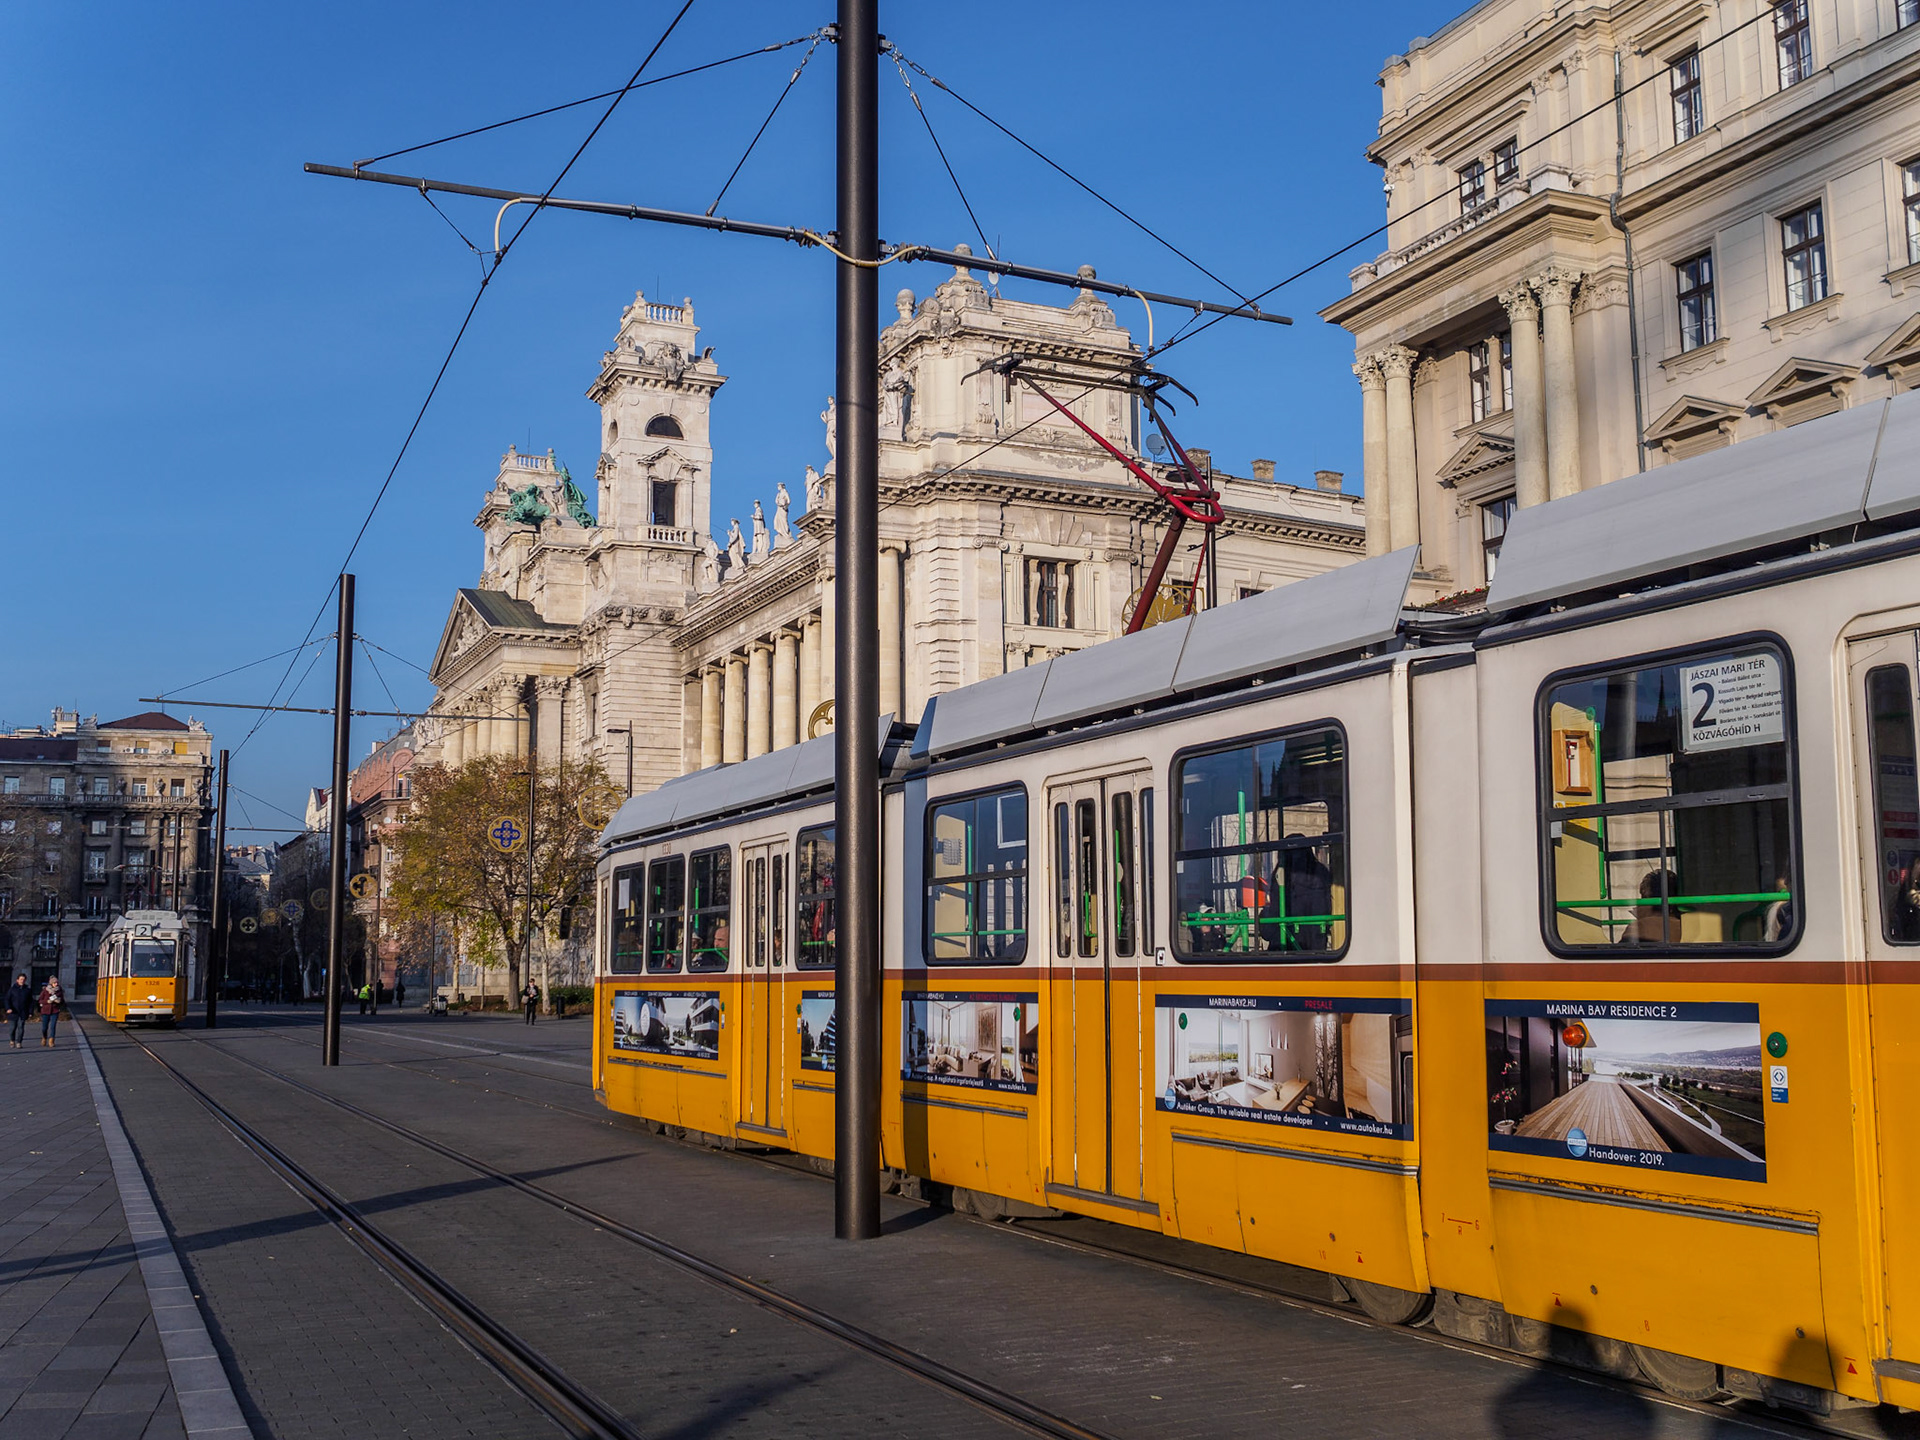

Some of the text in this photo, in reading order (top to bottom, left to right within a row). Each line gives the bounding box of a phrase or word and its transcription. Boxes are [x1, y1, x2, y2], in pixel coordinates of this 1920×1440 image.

[1690, 659, 1765, 681] JÁSZAI MARI TÉR
[1692, 682, 1717, 729] 2
[1692, 723, 1761, 742] KÖZVÁGÓHÍD H
[140, 926, 148, 936] 2
[1208, 997, 1257, 1009] MARINABAY2.HU
[1304, 999, 1333, 1011] PRESALE
[1546, 1004, 1677, 1018] MARINA BAY RESIDENCE 2
[1217, 1105, 1228, 1115] The
[1228, 1107, 1250, 1119] reliable
[1250, 1110, 1263, 1120] real
[1263, 1112, 1282, 1122] estate
[1282, 1113, 1313, 1126] developer
[1340, 1121, 1393, 1136] www.autoker.hu
[1588, 1146, 1665, 1166] Handover: 2019.
